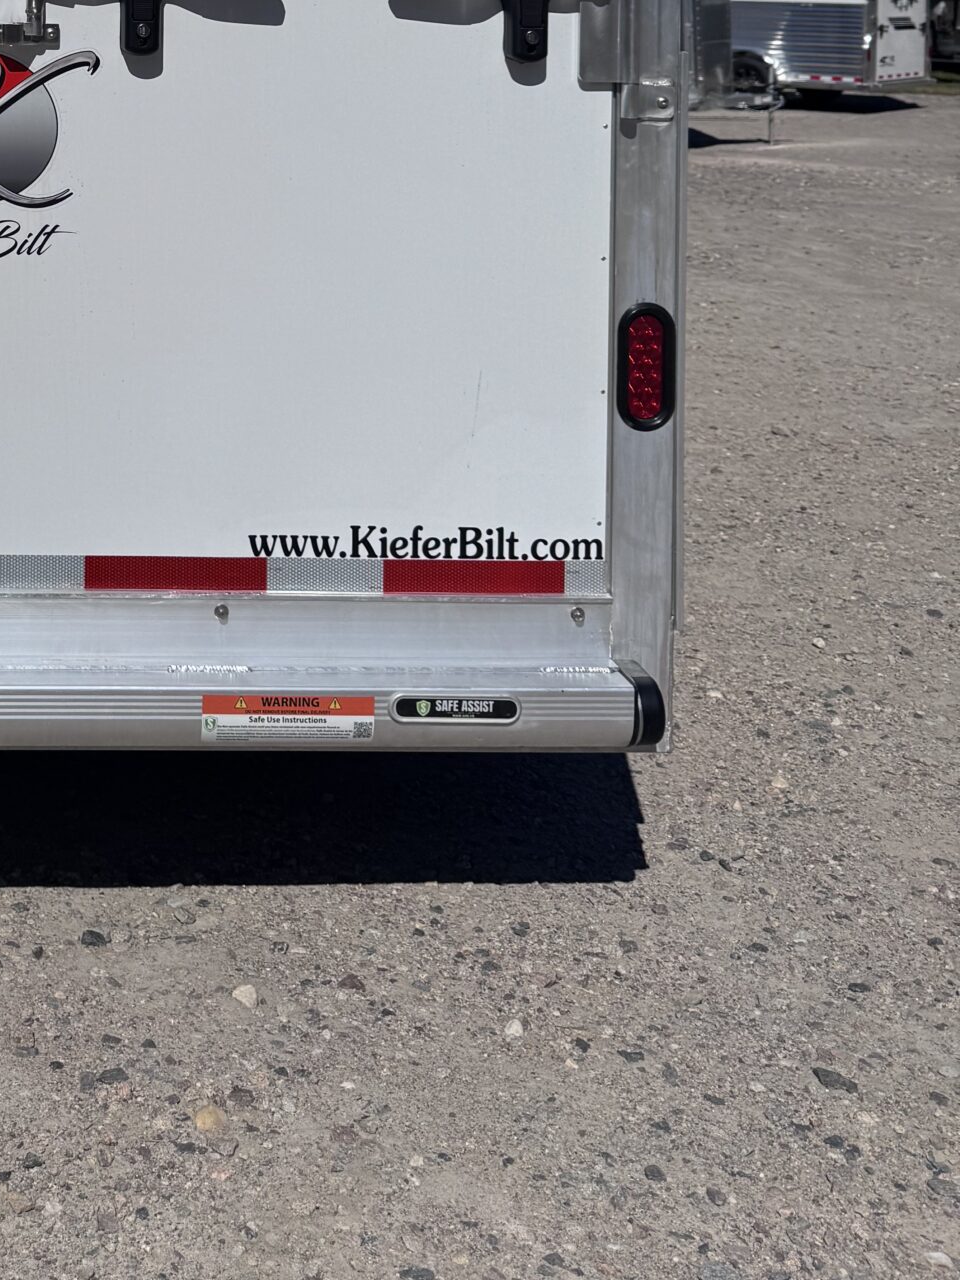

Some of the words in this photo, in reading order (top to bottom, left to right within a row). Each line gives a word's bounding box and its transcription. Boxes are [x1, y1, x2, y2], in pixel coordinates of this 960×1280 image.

[248, 525, 604, 561] www.KieferBilt.com
[261, 697, 320, 708] WARNING
[435, 700, 459, 712] SAFE
[461, 700, 495, 712] ASSIST
[248, 715, 266, 724] Safe
[267, 716, 281, 724] Use
[282, 716, 328, 724] Instructions
